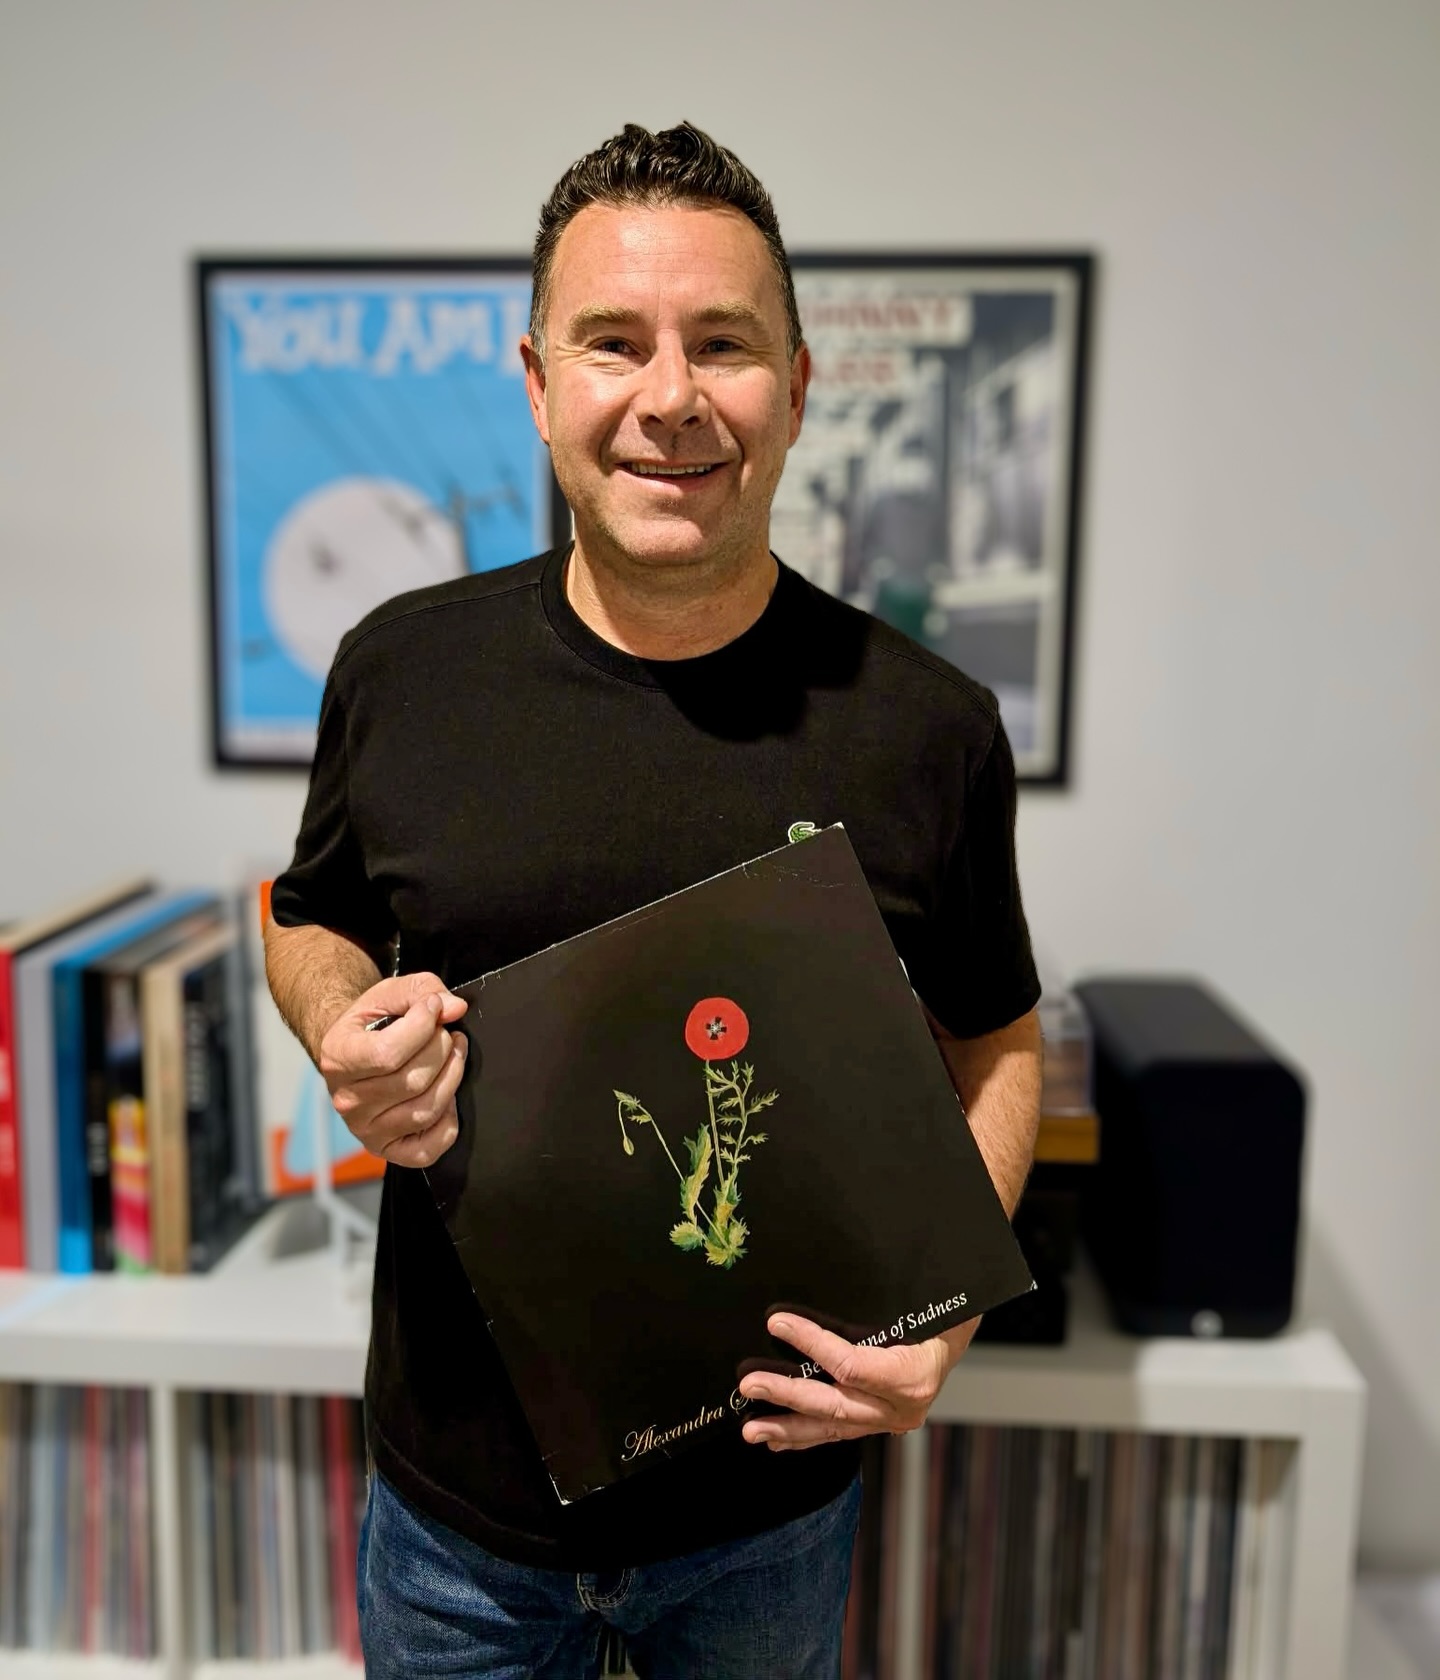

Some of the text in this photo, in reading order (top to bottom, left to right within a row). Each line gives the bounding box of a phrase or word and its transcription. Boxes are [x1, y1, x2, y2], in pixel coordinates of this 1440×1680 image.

[621, 1405, 725, 1461] Alexandra
[890, 1316, 904, 1339] of
[906, 1292, 968, 1329] Sadness
